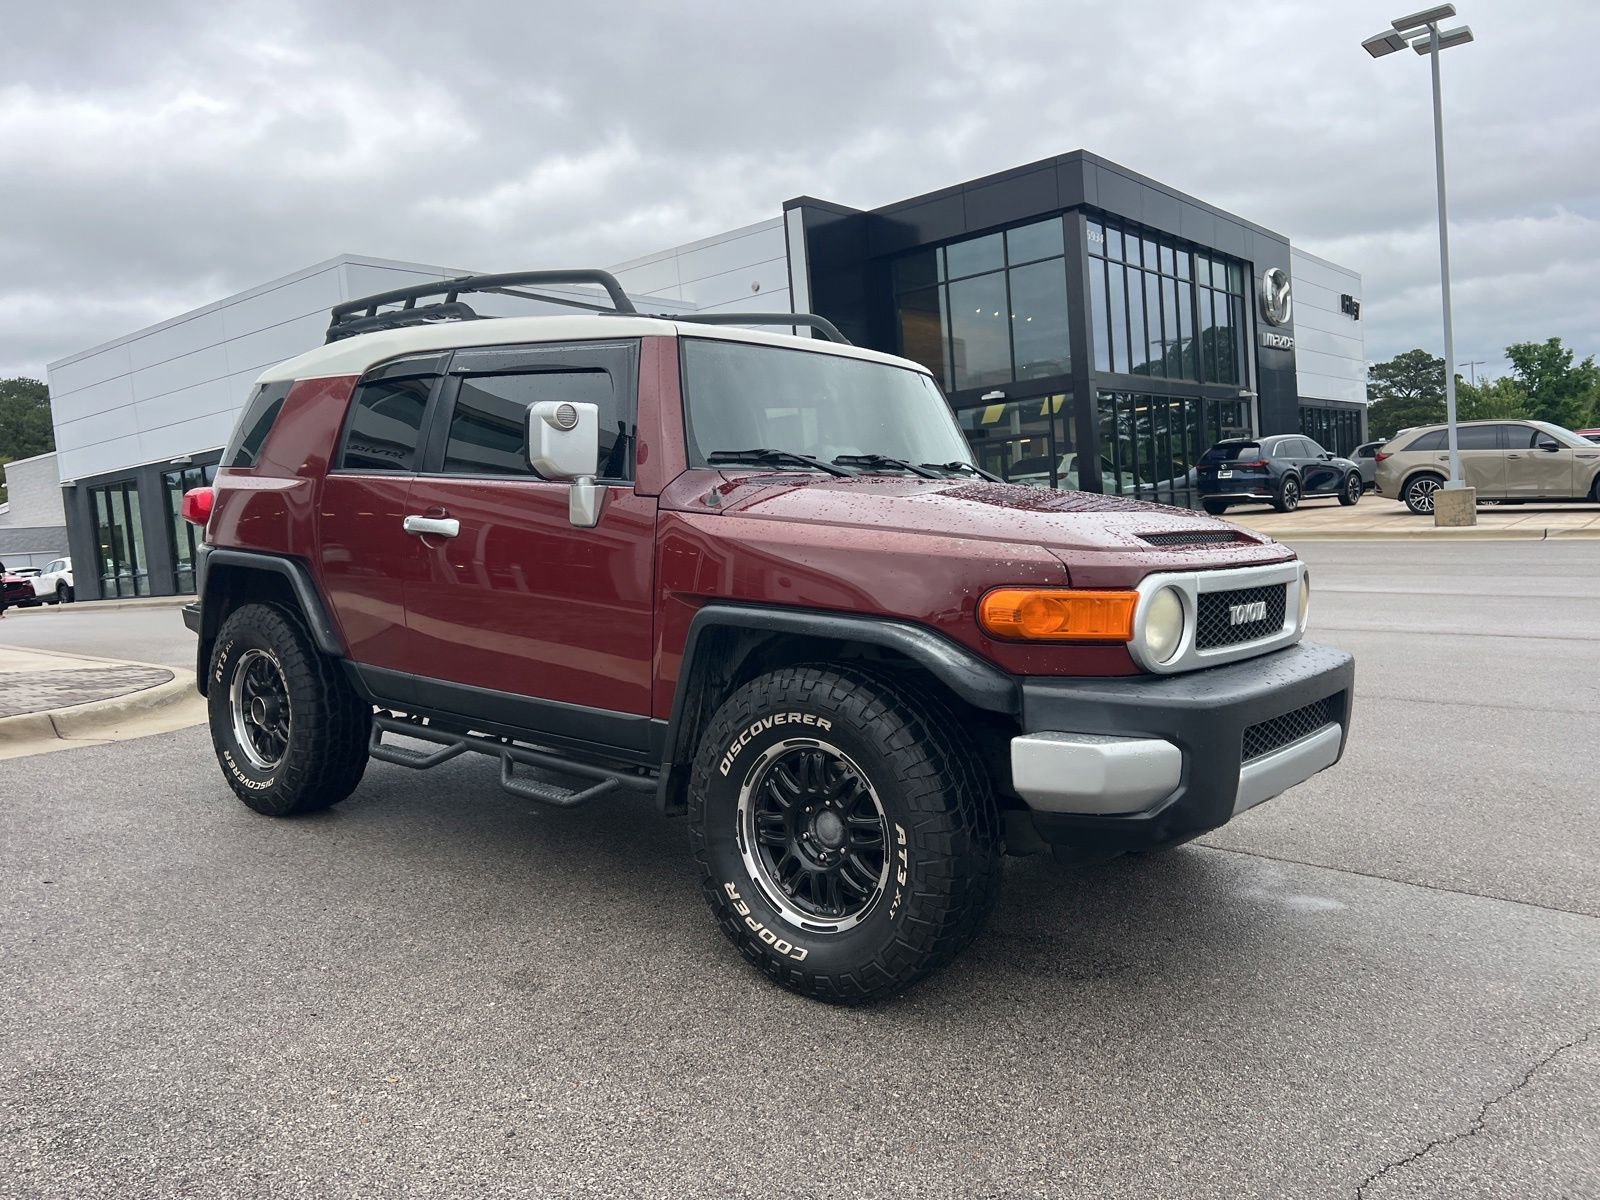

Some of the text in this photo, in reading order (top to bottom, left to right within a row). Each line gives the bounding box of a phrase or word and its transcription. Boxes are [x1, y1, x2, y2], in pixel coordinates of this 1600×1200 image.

[1229, 601, 1267, 626] TOYOTA
[215, 651, 228, 683] AT3
[223, 750, 275, 791] DISCOVERER
[719, 712, 832, 777] DISCOVERER
[895, 823, 908, 887] AT3
[723, 881, 809, 962] COOPER
